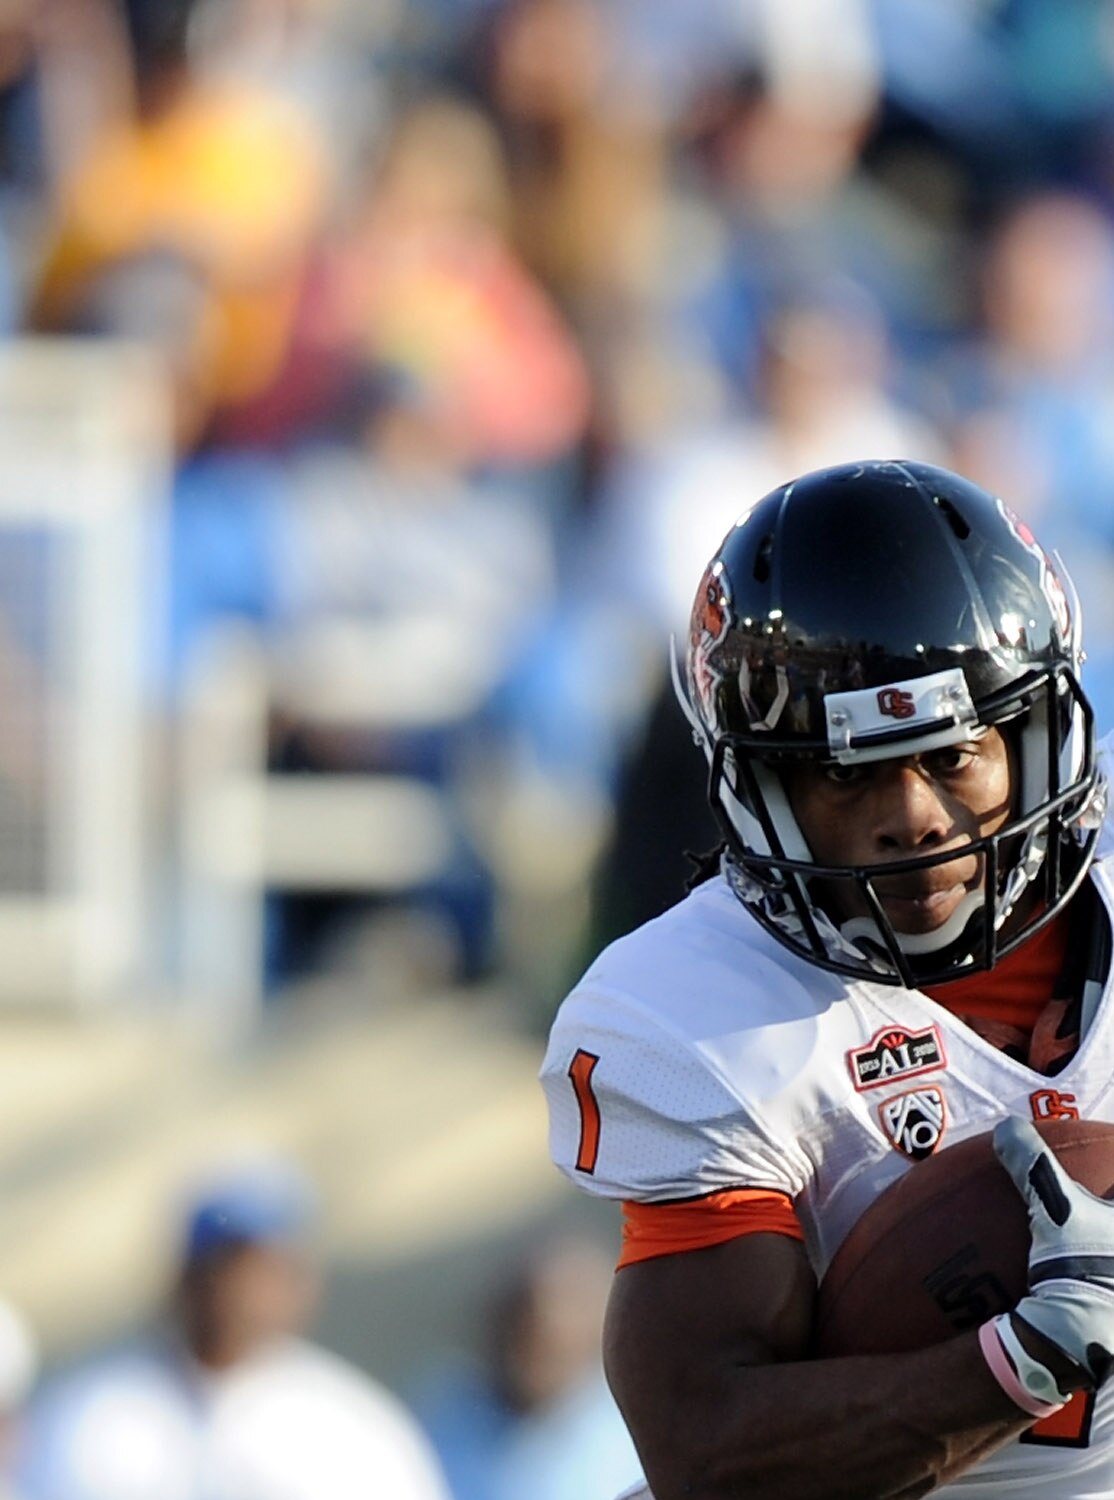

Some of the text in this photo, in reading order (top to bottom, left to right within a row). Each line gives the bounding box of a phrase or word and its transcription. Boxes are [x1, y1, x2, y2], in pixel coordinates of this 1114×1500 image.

[878, 1043, 923, 1079] AL
[568, 1047, 602, 1176] 1
[904, 1121, 939, 1154] 10
